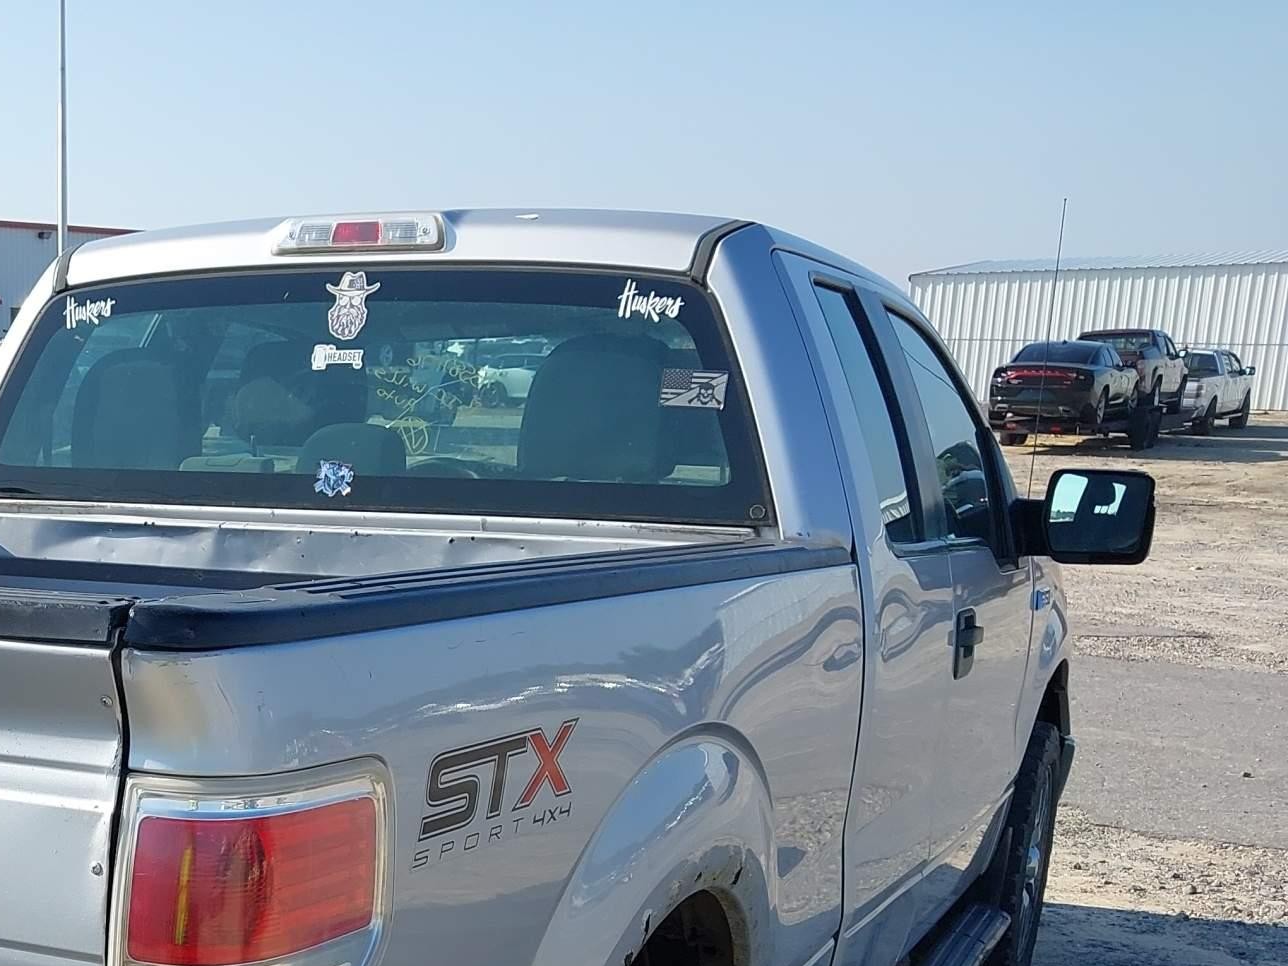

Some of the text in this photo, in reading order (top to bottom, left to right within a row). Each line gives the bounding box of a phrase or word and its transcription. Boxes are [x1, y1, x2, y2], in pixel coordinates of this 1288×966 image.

[62, 295, 116, 330] Huskers
[617, 278, 686, 323] Huskers
[327, 351, 362, 362] HEADSET
[417, 716, 581, 843] STX
[410, 817, 525, 870] SPORT
